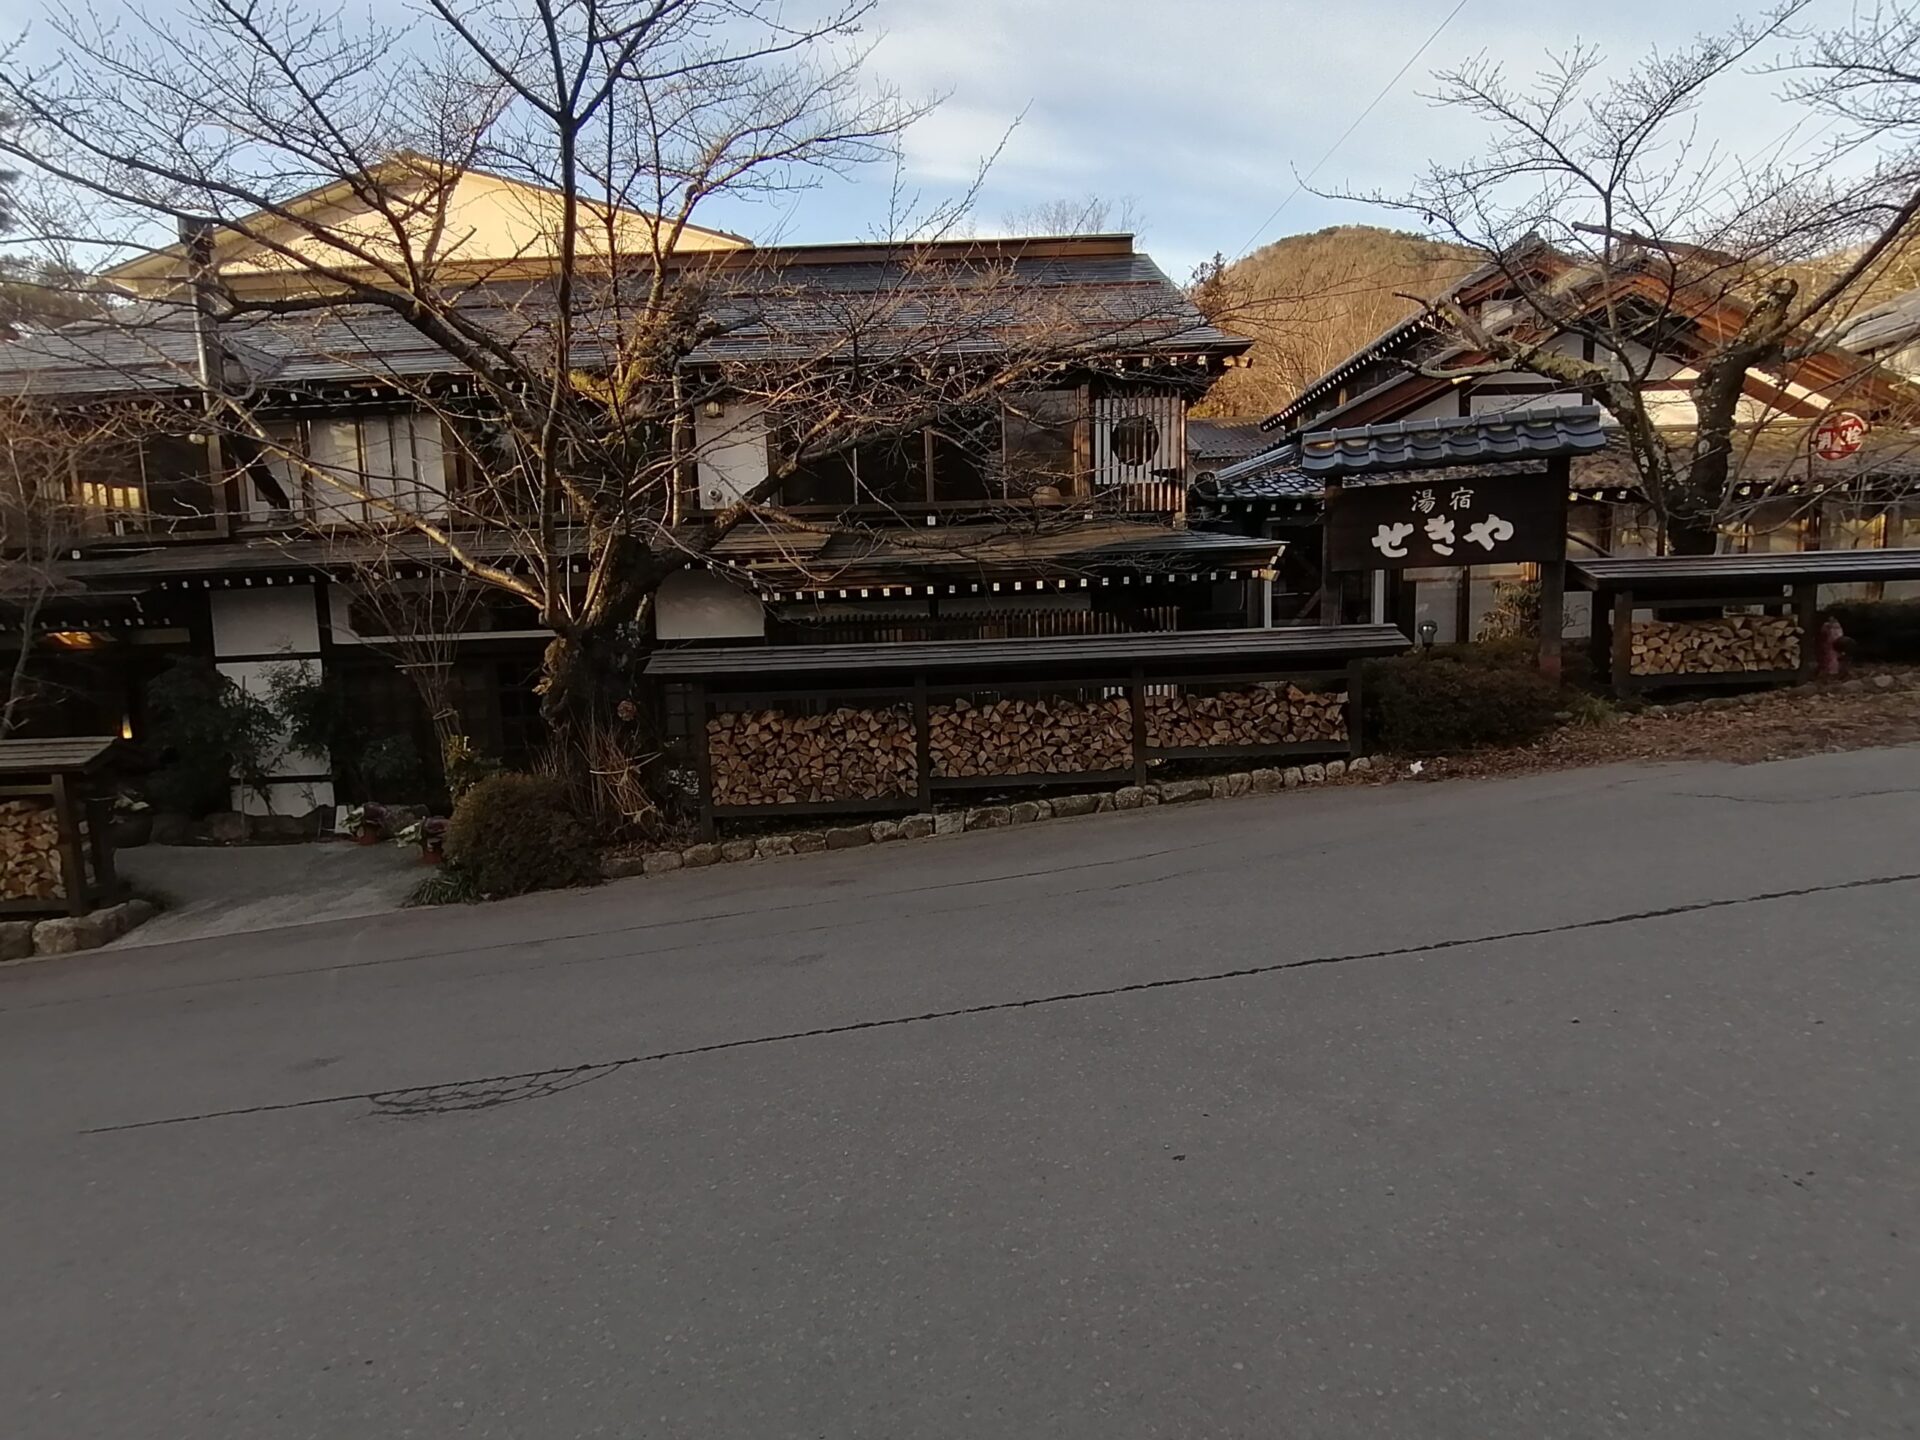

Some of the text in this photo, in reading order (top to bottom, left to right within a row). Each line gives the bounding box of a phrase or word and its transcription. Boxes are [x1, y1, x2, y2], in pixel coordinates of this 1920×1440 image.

[1411, 486, 1475, 514] 湯宿
[1371, 513, 1514, 558] せきや
